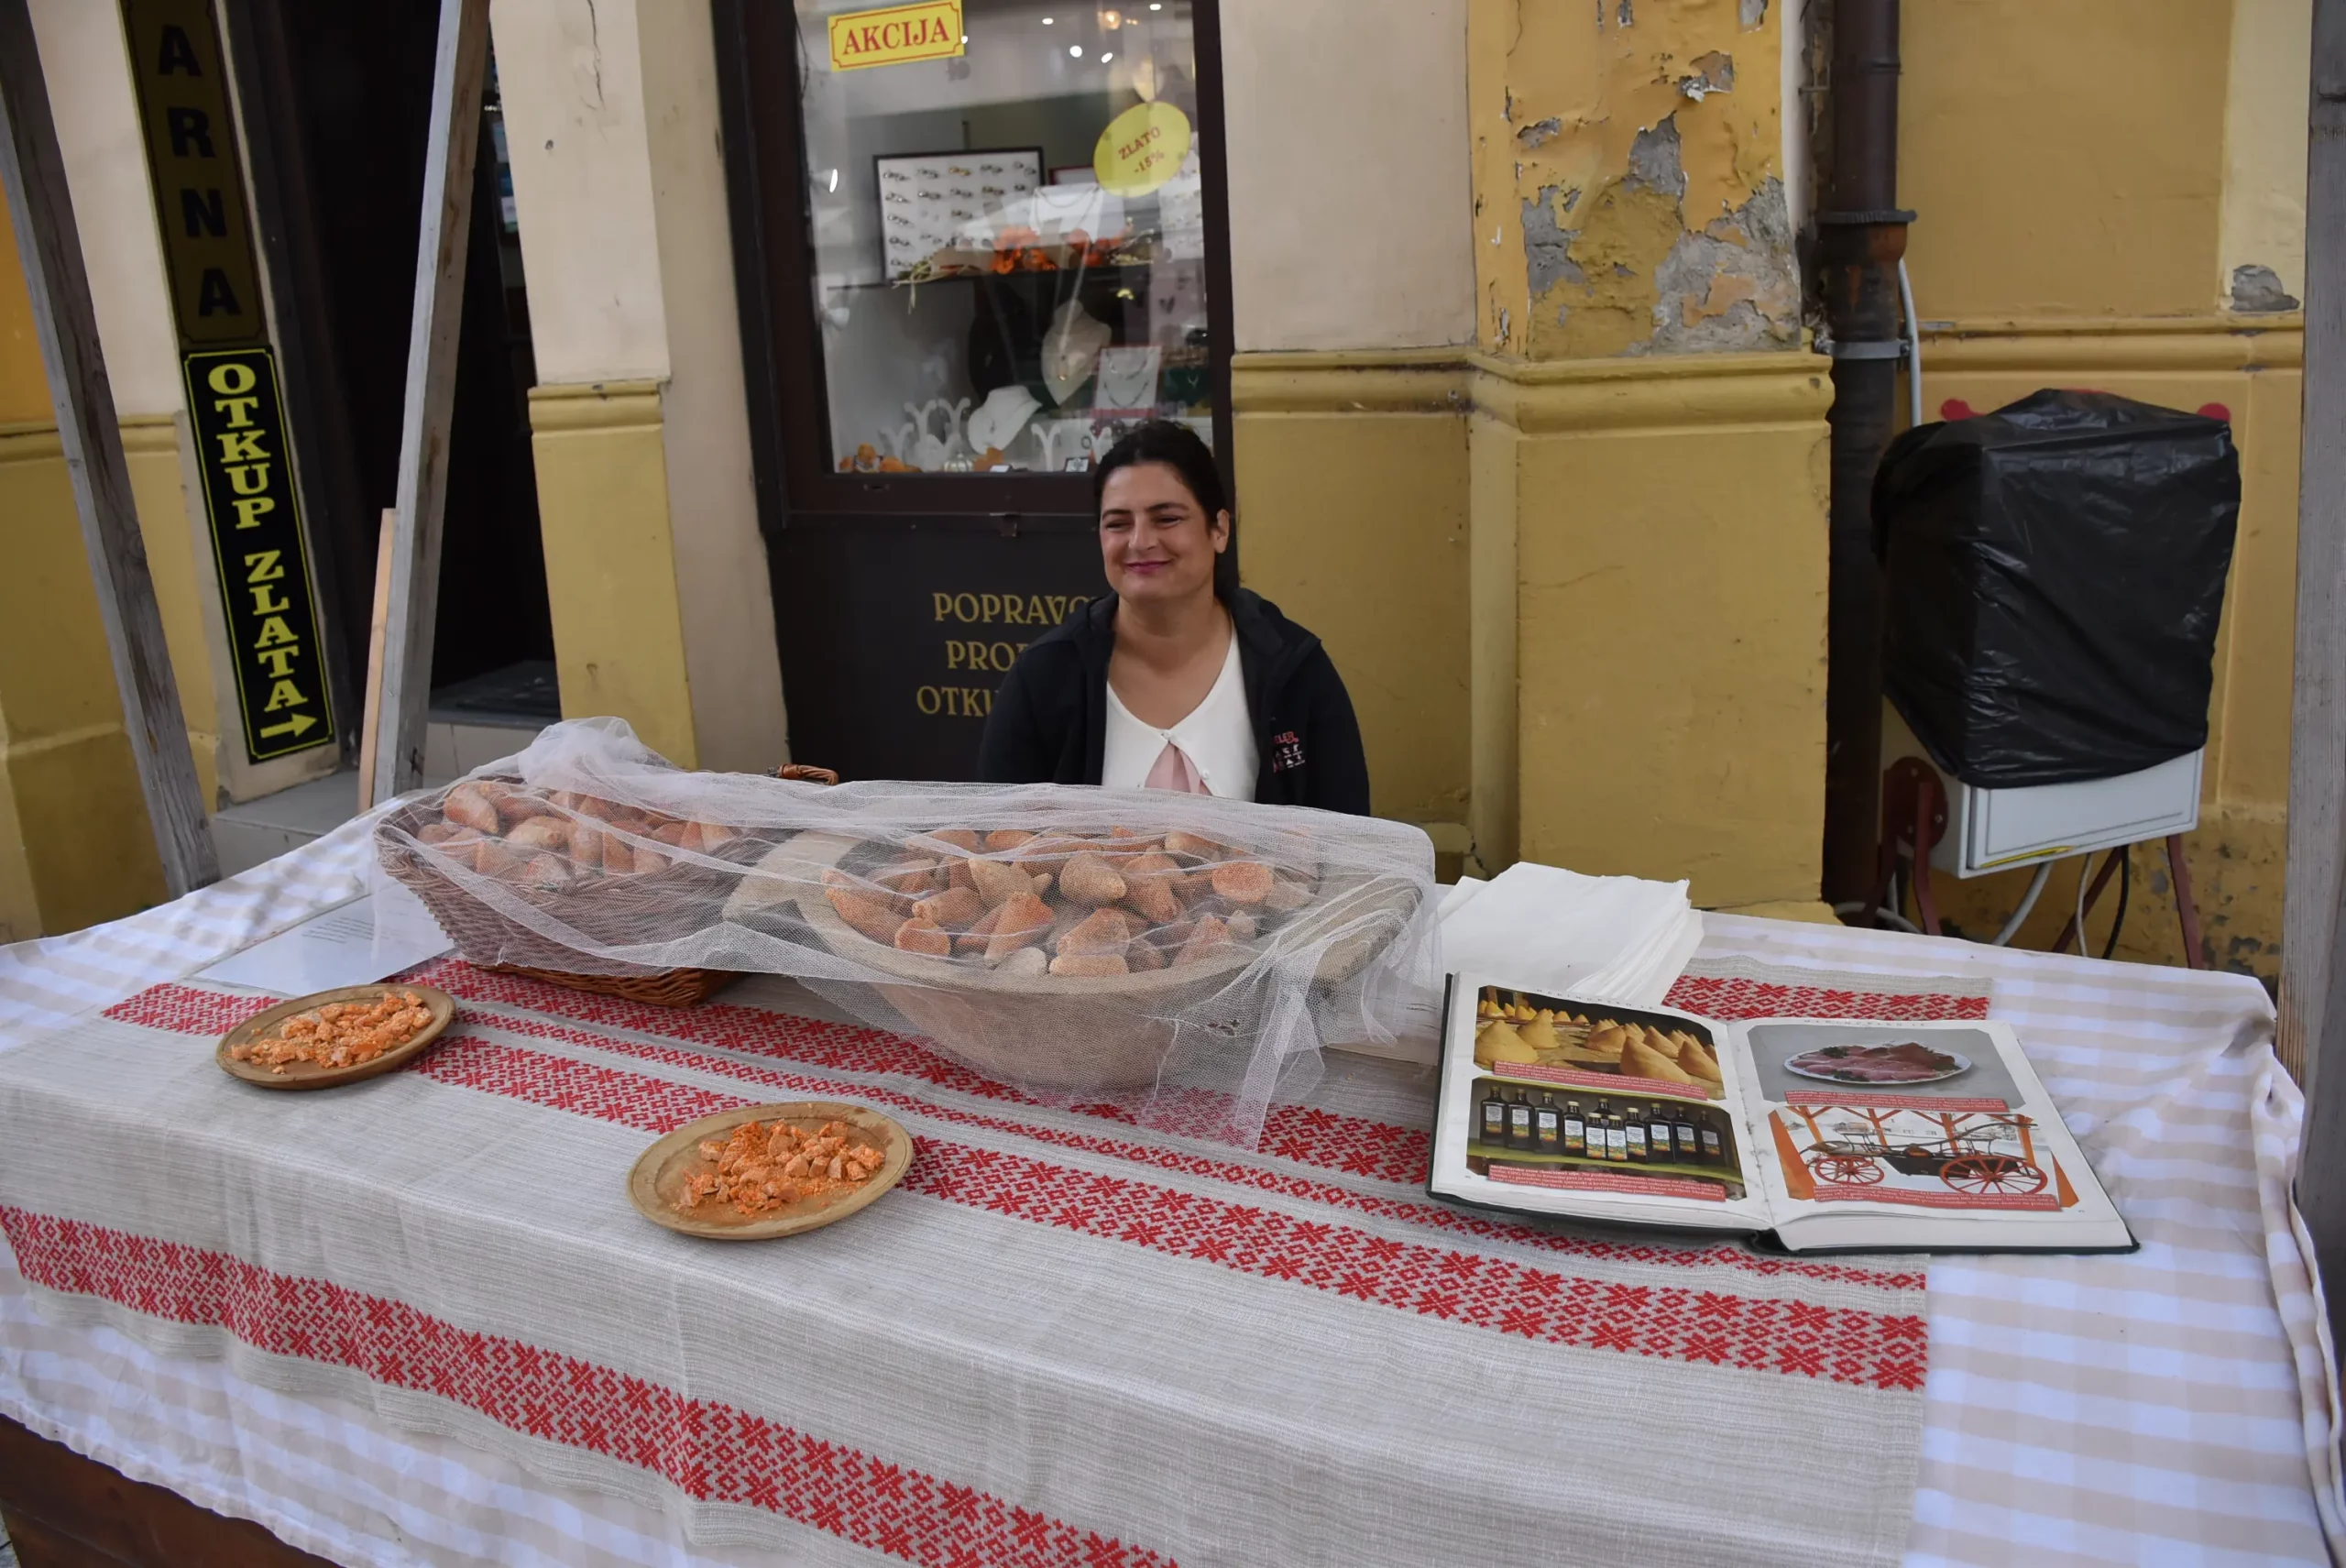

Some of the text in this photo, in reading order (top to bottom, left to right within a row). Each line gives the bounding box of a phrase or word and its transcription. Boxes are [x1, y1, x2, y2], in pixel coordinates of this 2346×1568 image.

[842, 16, 950, 55] AKCIJA
[1118, 126, 1160, 160] ZLATO
[207, 363, 309, 712] OTKUP ZLATA
